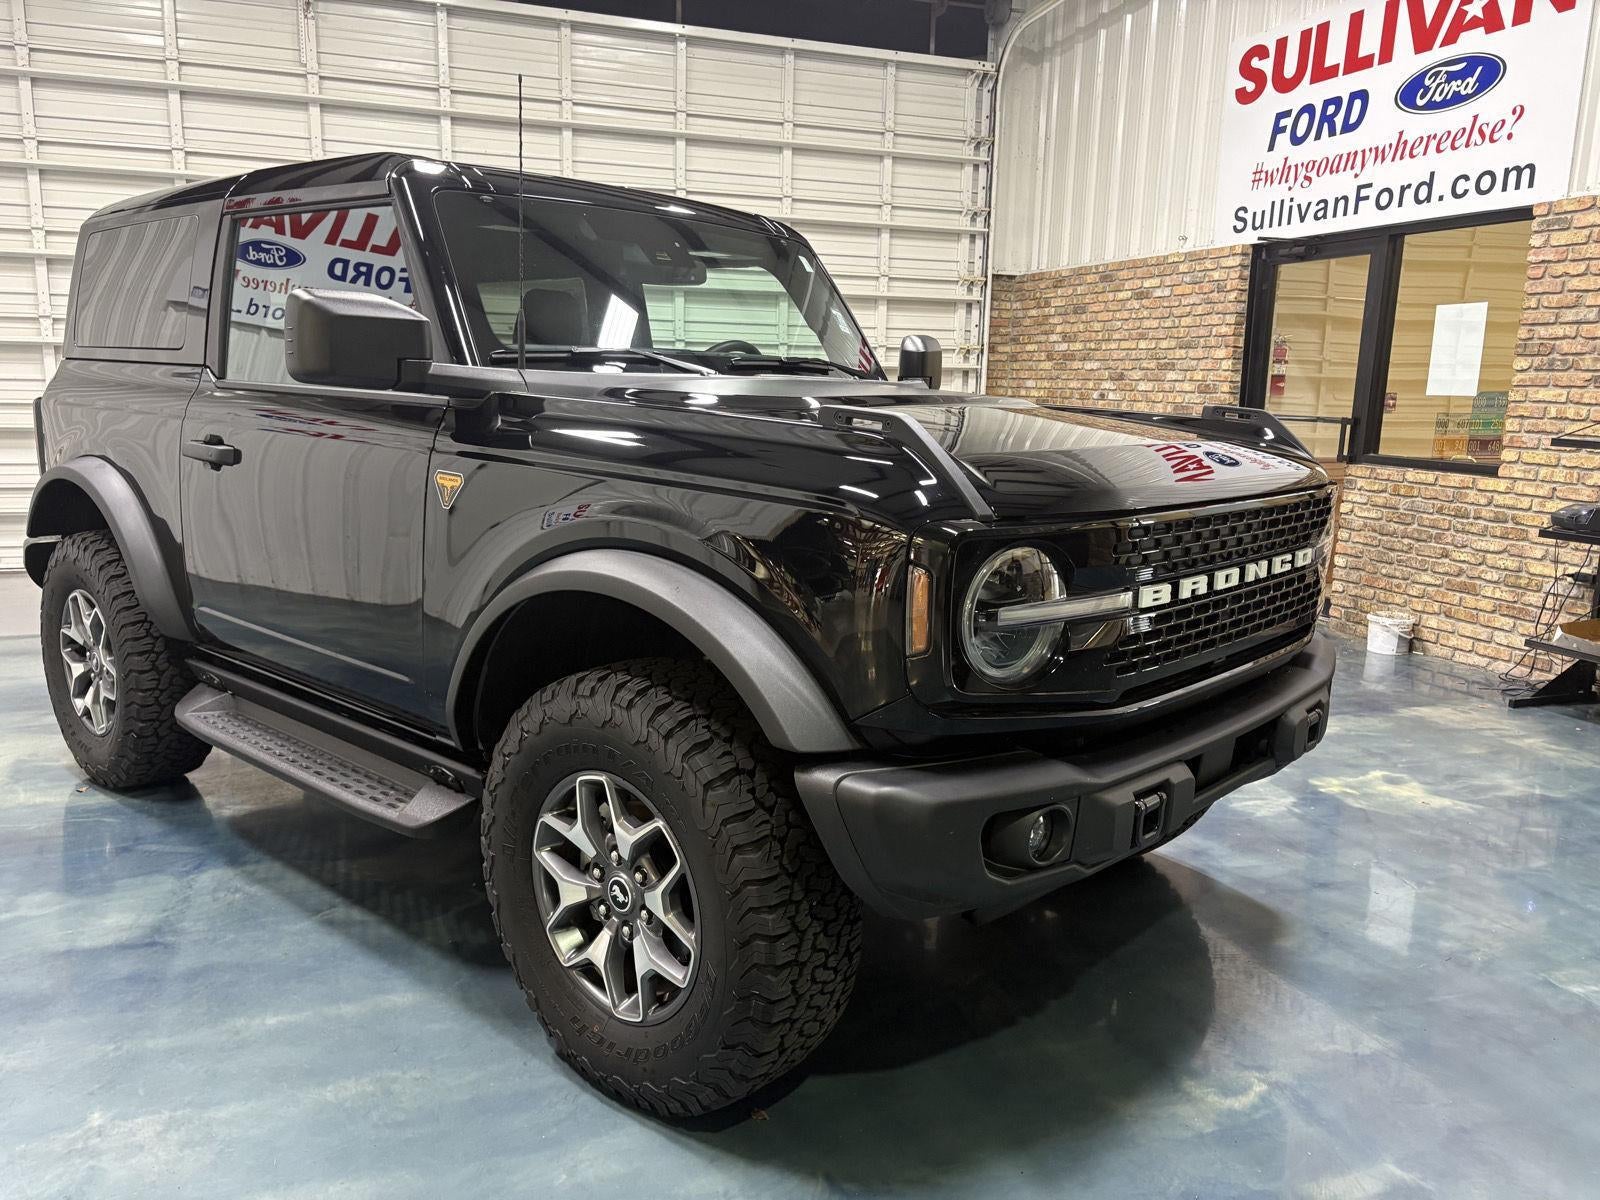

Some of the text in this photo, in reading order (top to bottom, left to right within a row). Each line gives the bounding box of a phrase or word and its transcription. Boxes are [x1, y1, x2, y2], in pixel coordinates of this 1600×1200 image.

[1414, 61, 1485, 107] Ford
[1250, 103, 1526, 192] #whygoanywhereelse?
[1267, 88, 1370, 153] FORD
[1232, 162, 1537, 234] SullivanFord.com
[1138, 548, 1313, 609] BRONCO
